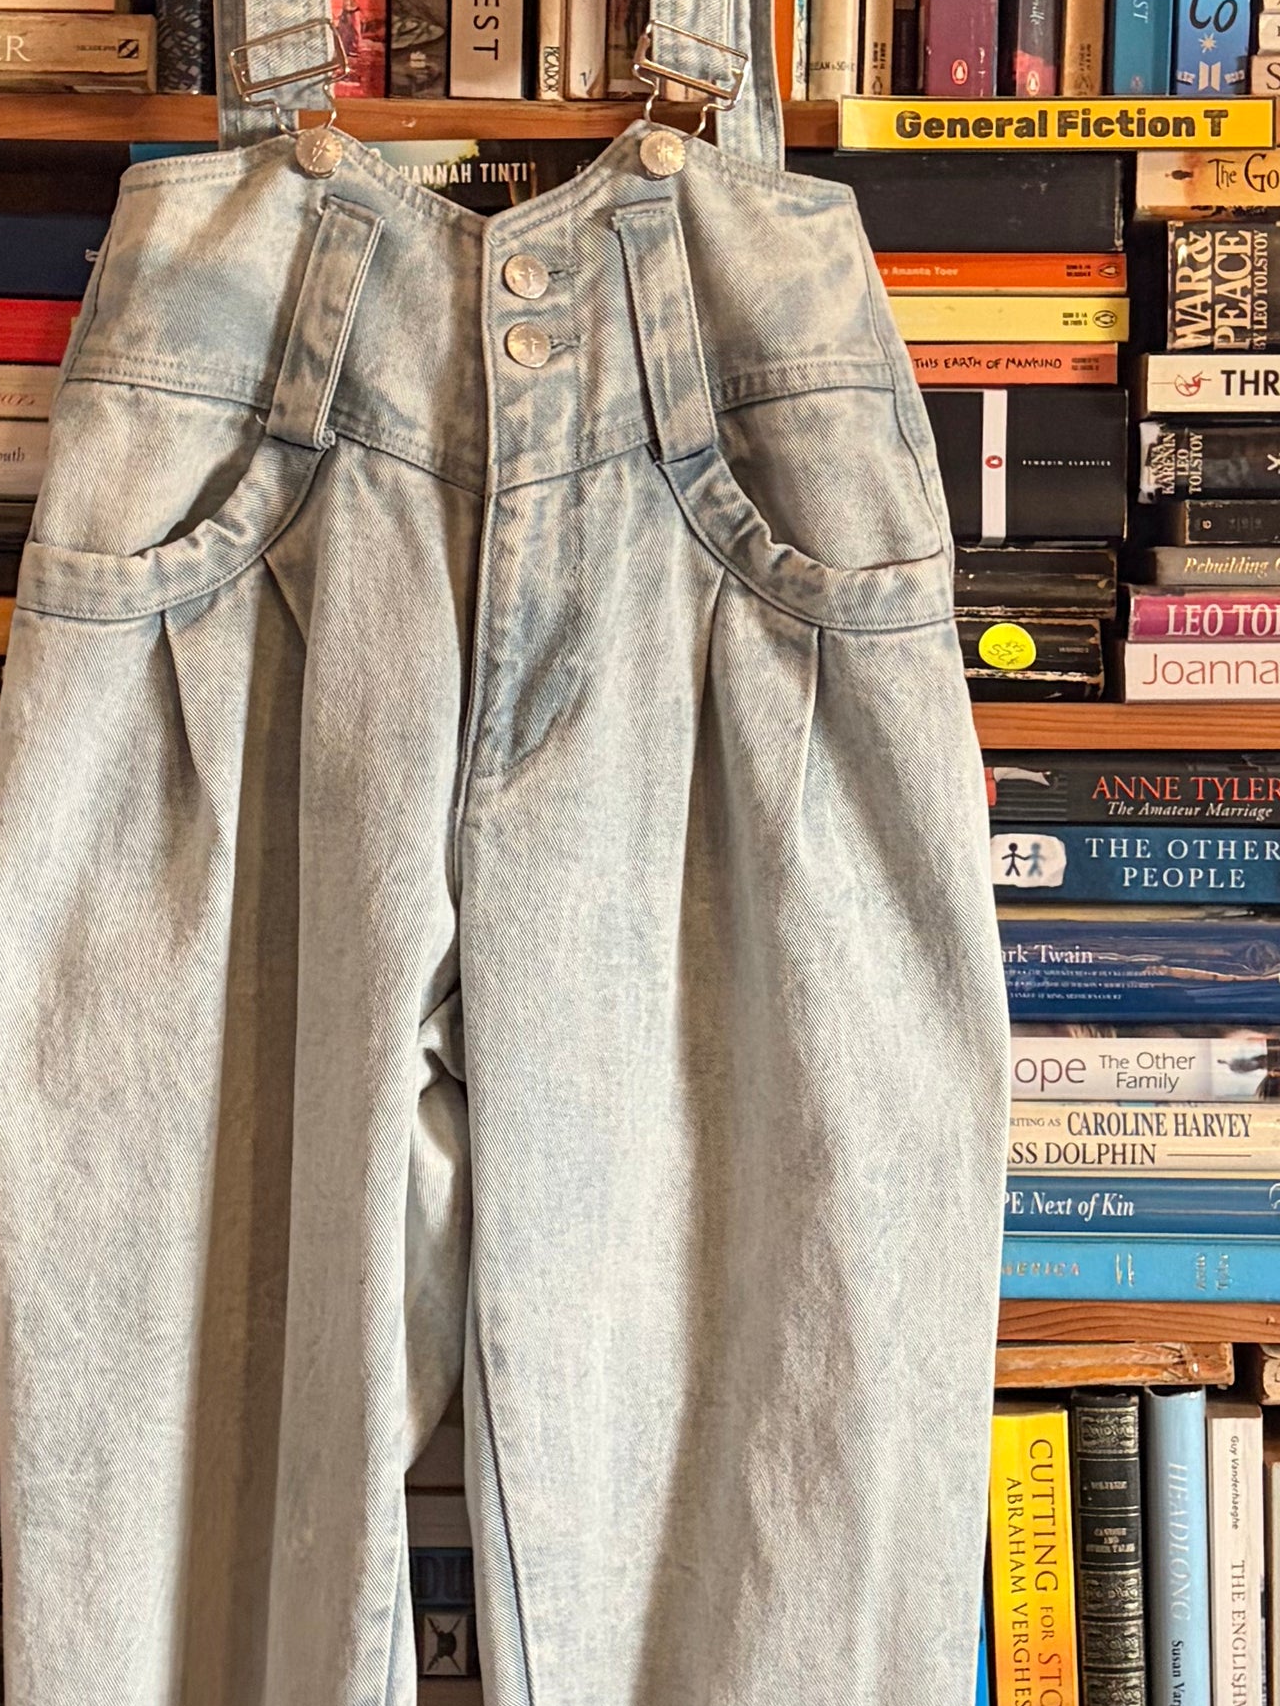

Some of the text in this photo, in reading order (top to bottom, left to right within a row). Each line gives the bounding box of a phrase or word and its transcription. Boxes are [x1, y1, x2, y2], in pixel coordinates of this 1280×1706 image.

[896, 110, 1228, 140] General Fiction T
[1092, 775, 1186, 802] ANNE
[1085, 837, 1159, 858] THE
[1122, 865, 1246, 889] PEOPLE
